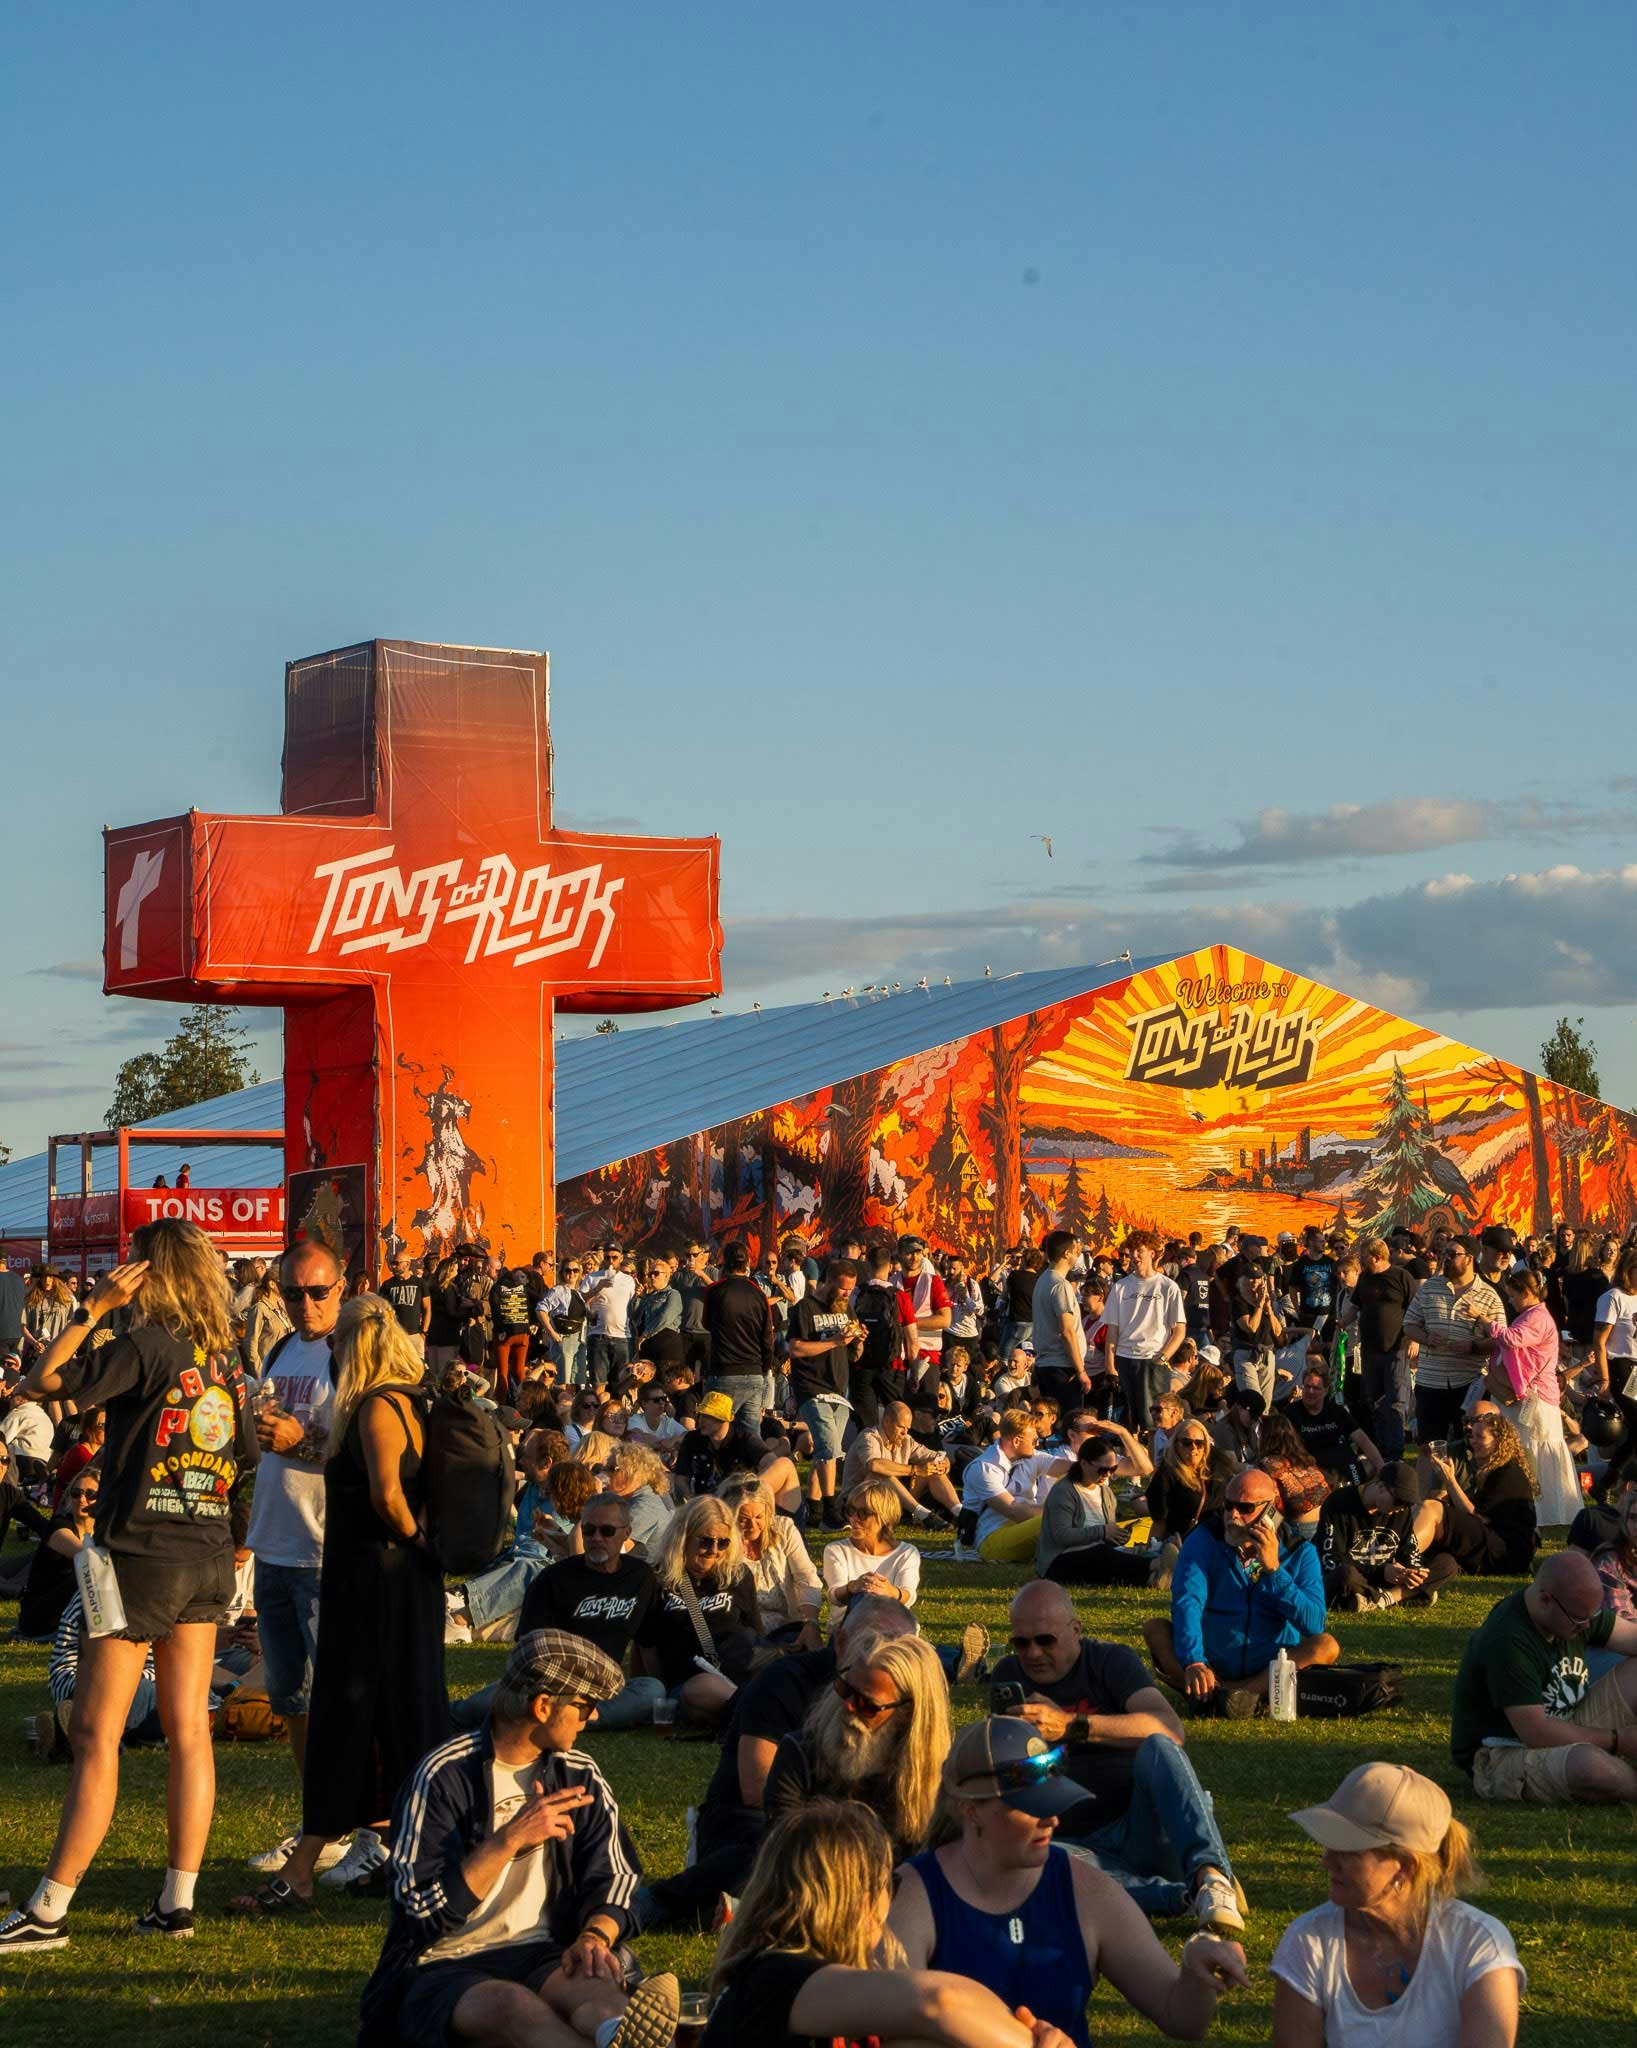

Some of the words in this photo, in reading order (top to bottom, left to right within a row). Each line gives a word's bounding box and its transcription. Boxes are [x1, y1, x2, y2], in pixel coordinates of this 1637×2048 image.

[306, 844, 464, 956] TONS
[443, 853, 625, 970] ROCK
[1176, 973, 1271, 1010] Welcome
[1272, 983, 1289, 998] TO
[1123, 1001, 1220, 1080] TONS
[1209, 1003, 1324, 1082] ROCK
[146, 1198, 223, 1221] TONS
[232, 1198, 269, 1221] OF
[83, 1569, 99, 1613] APOTEK
